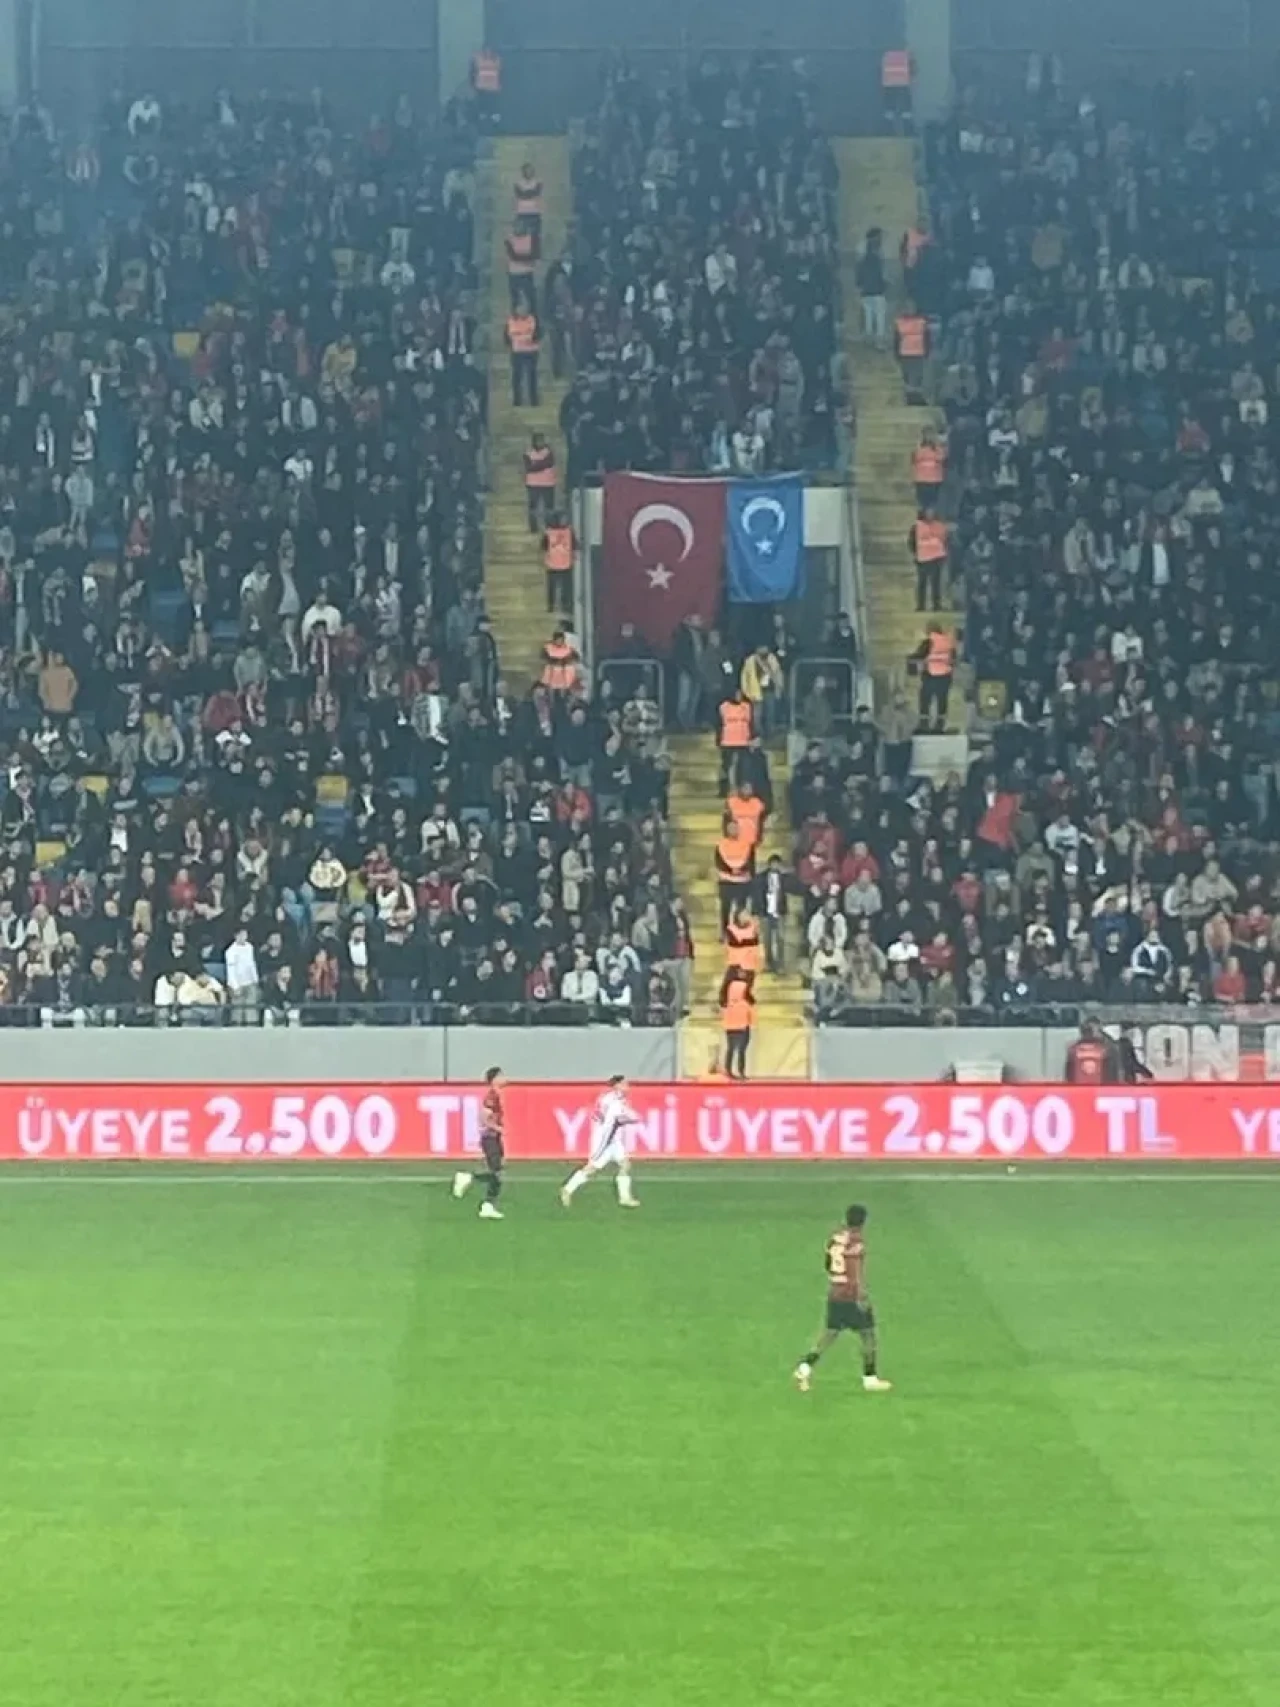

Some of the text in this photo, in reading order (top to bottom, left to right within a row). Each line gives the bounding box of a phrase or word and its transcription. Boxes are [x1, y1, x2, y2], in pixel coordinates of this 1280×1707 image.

[1102, 1024, 1240, 1082] ON
[17, 1097, 191, 1153] ÜYEYE
[204, 1095, 398, 1153] 2.500
[552, 1093, 1177, 1153] YNİ ÜYEYE 2.500 TL
